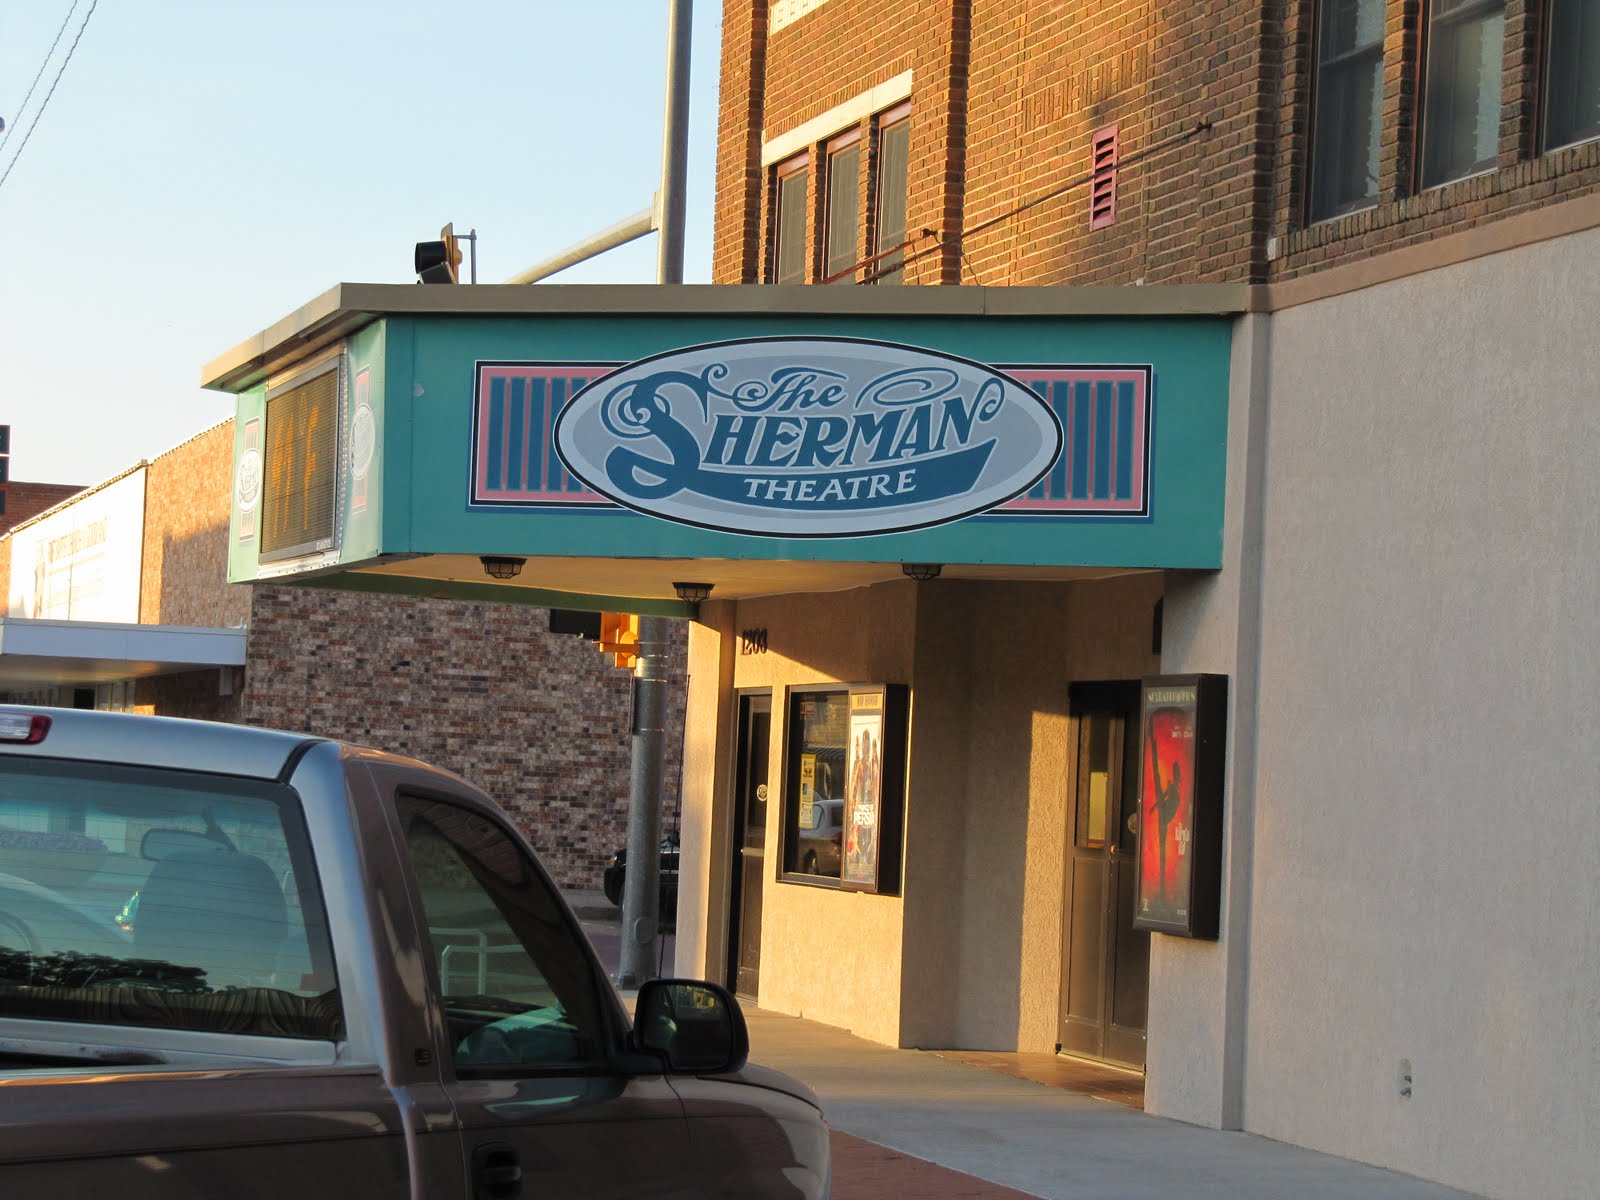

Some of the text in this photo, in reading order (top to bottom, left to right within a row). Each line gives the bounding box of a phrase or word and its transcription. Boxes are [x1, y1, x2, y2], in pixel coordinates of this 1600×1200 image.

[731, 366, 848, 413] The
[600, 362, 1005, 500] SHERMAN
[743, 468, 917, 502] THEATRE
